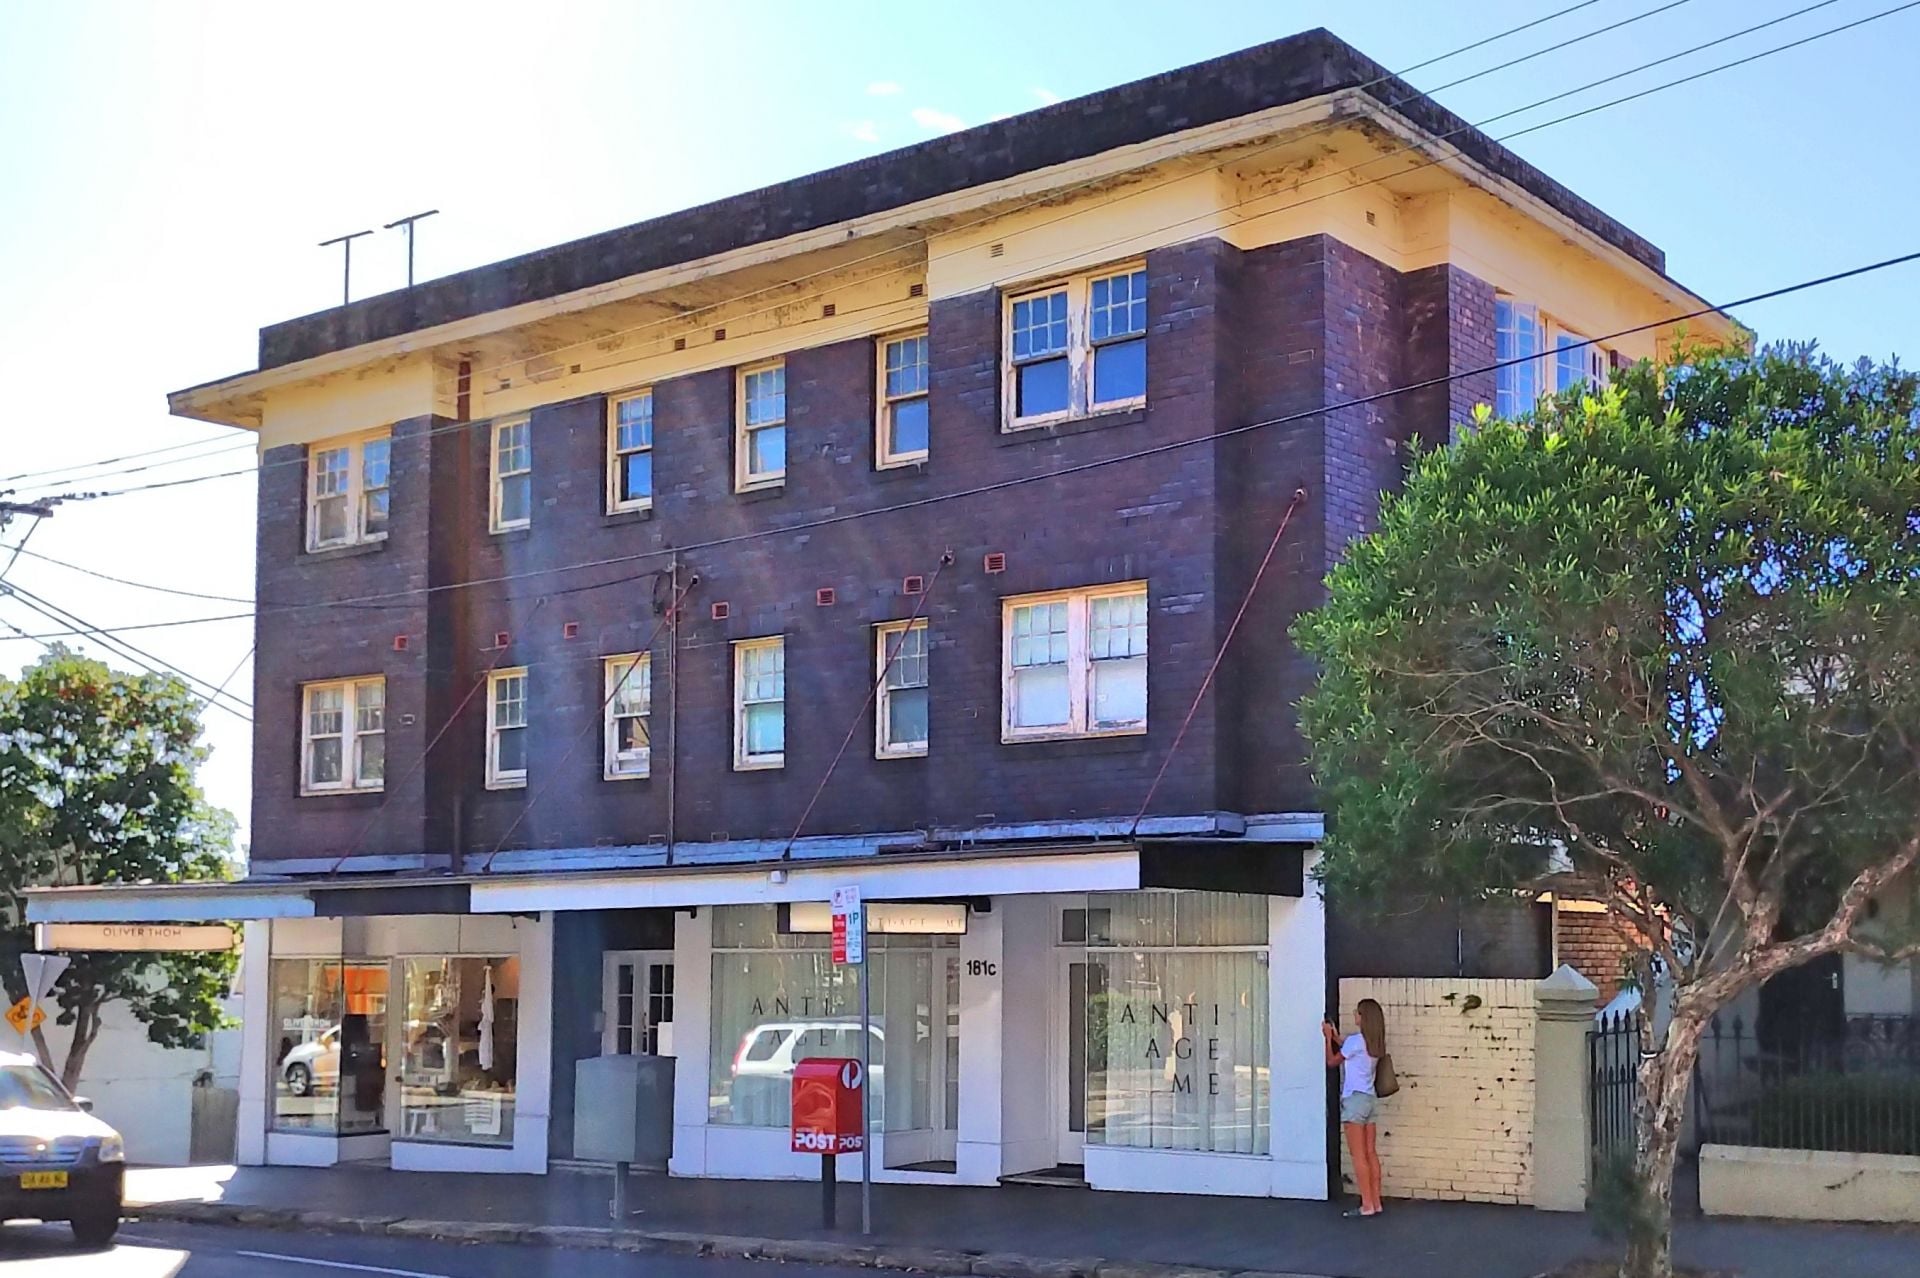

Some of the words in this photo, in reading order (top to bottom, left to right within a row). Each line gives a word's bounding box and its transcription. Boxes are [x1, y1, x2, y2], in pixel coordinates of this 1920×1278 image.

[848, 911, 859, 925] 1P
[103, 927, 144, 937] OLIVER
[148, 927, 182, 937] THOM
[966, 959, 997, 976] 181c
[751, 996, 829, 1016] ANTI
[1120, 1003, 1219, 1026] ANTI
[1145, 1037, 1219, 1060] AGE
[1171, 1073, 1219, 1095] ME
[795, 1132, 836, 1150] POST
[839, 1136, 863, 1150] POS
